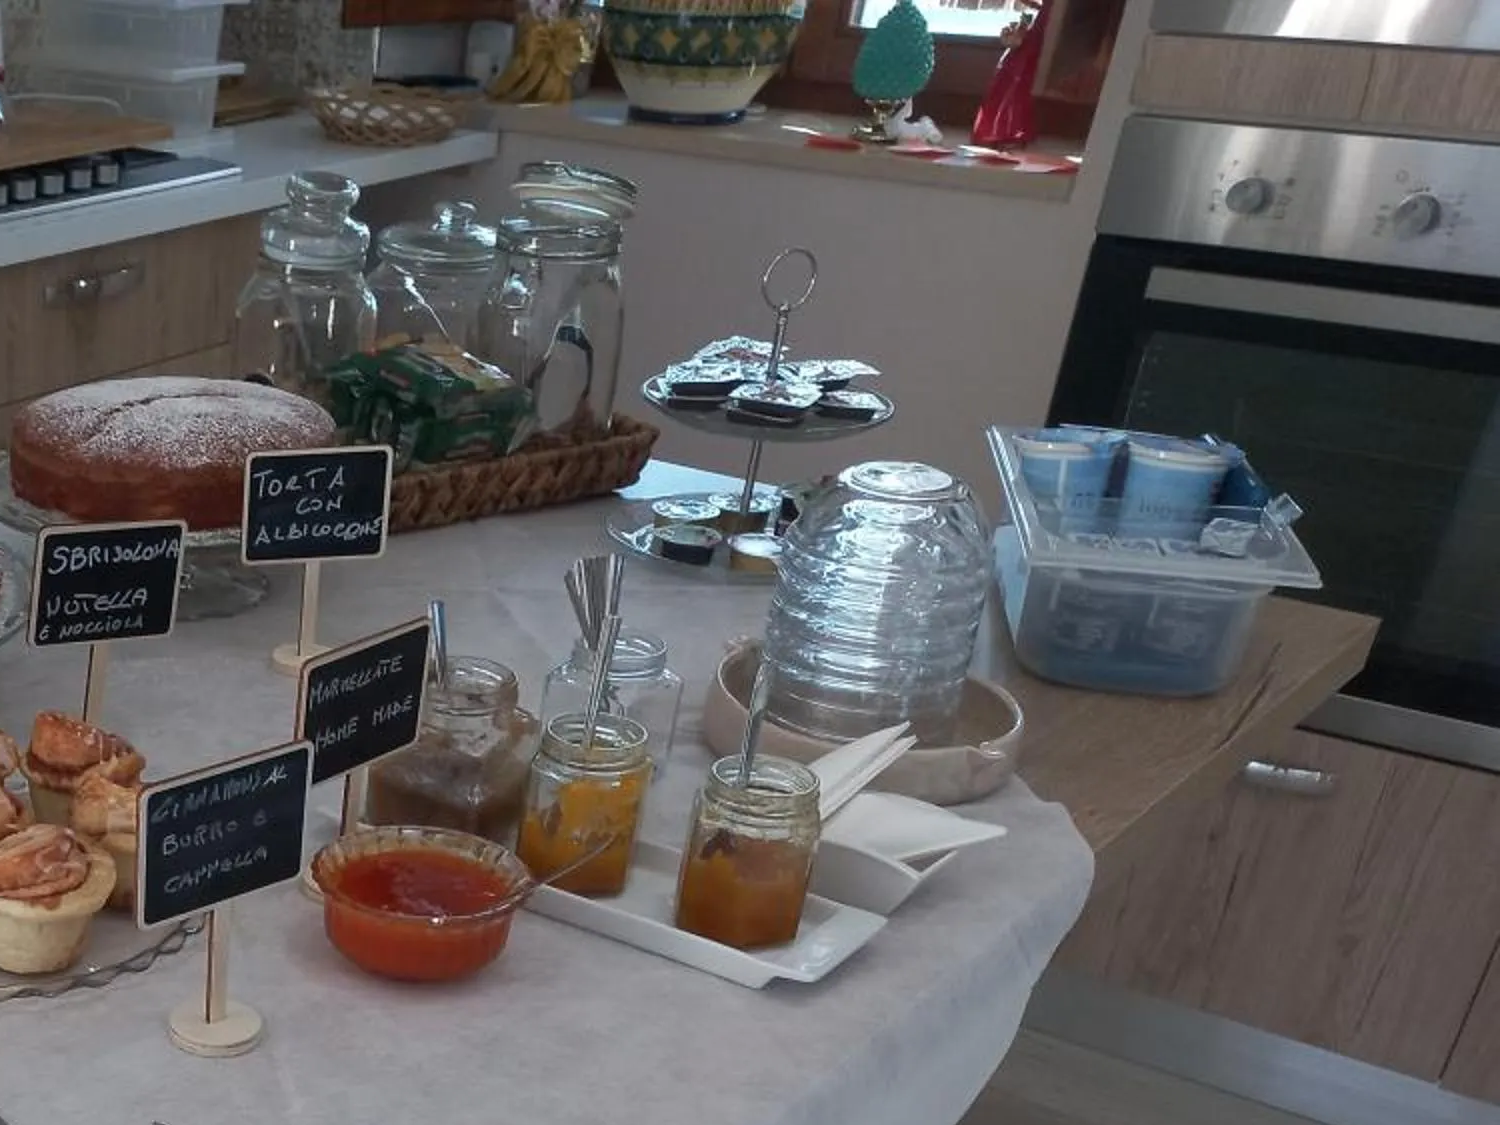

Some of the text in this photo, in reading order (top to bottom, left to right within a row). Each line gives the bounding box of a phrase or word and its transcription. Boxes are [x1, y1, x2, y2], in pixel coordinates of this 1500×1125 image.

[252, 465, 345, 498] TORTA
[295, 496, 343, 514] CON
[46, 588, 148, 618] NUTELLA
[309, 655, 404, 712] MARMELLATE
[315, 695, 413, 752] HOME MADE
[162, 819, 239, 856] BURRO
